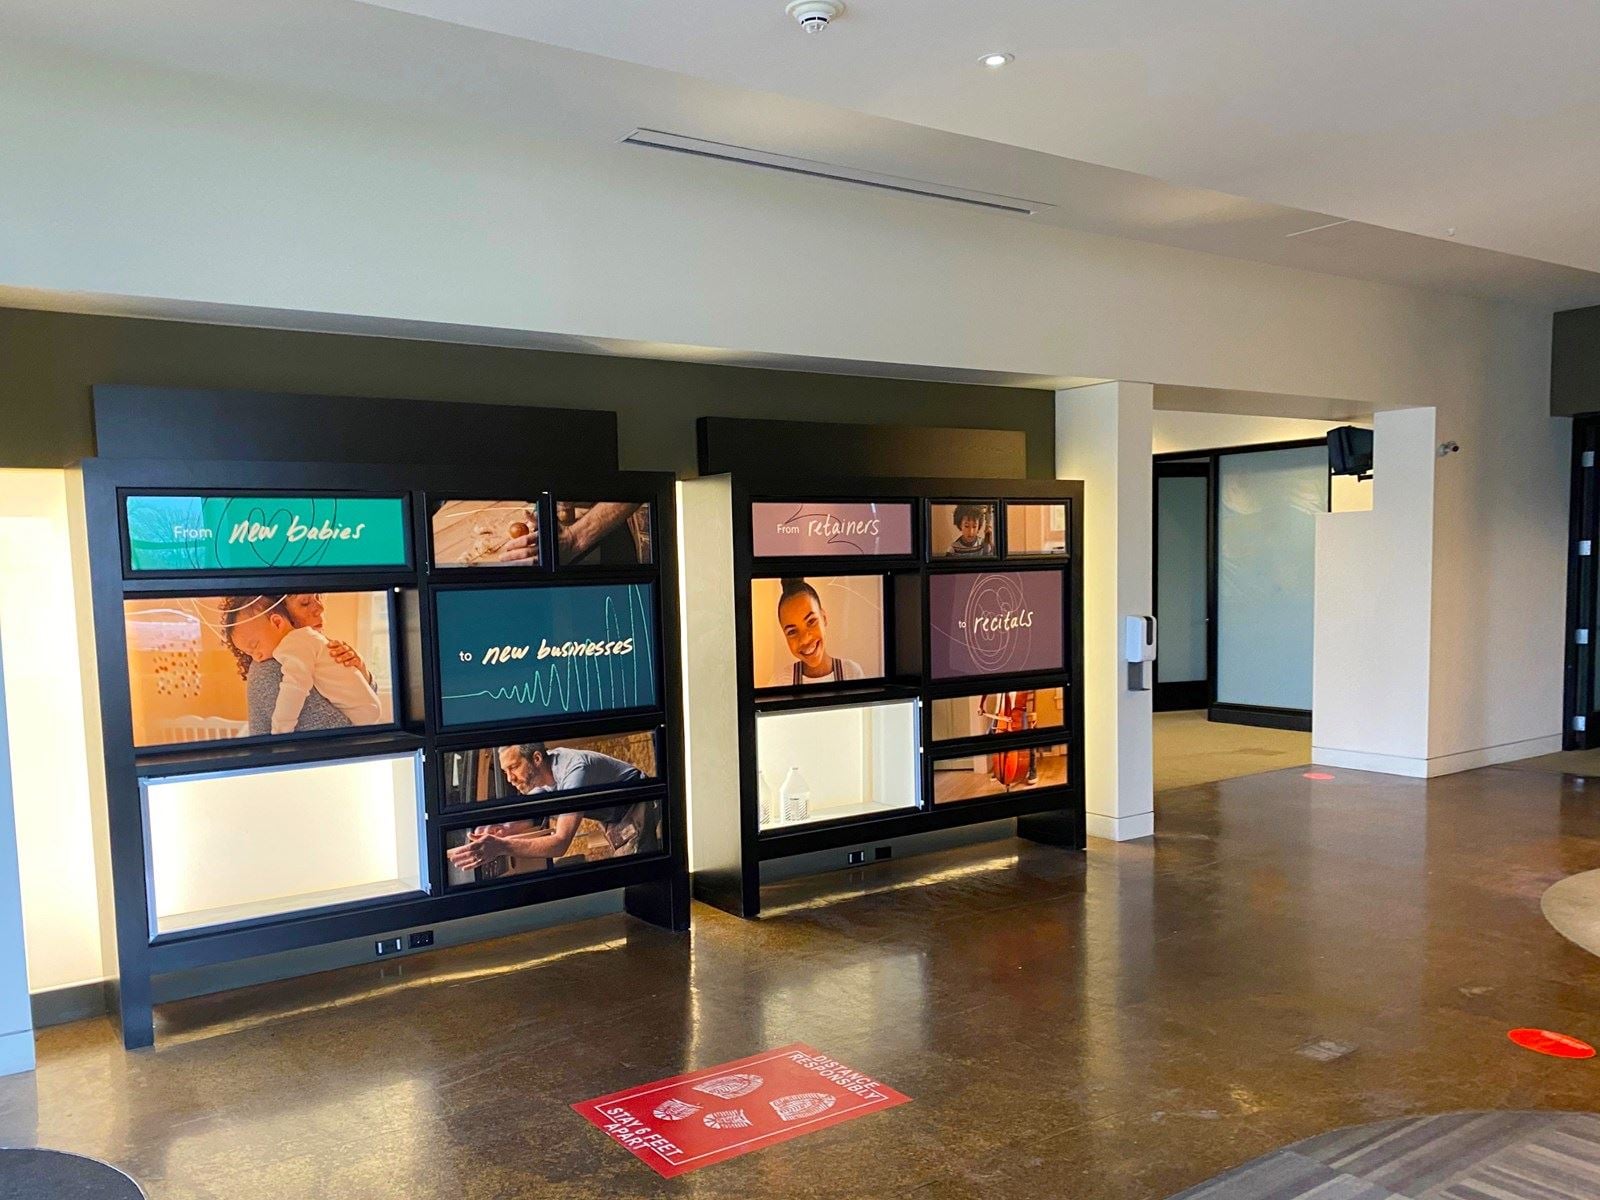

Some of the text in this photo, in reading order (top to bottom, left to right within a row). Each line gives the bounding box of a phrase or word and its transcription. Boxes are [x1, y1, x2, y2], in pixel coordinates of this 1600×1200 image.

[173, 515, 366, 544] From new babies
[776, 513, 881, 537] From retainers
[958, 609, 1034, 634] to recitals
[459, 637, 633, 665] to new businesses
[788, 1053, 880, 1100] RESPONSIBLY
[811, 1055, 880, 1089] DISTANCE
[603, 1122, 651, 1150] APART
[606, 1107, 684, 1157] STAY 6 FEET
